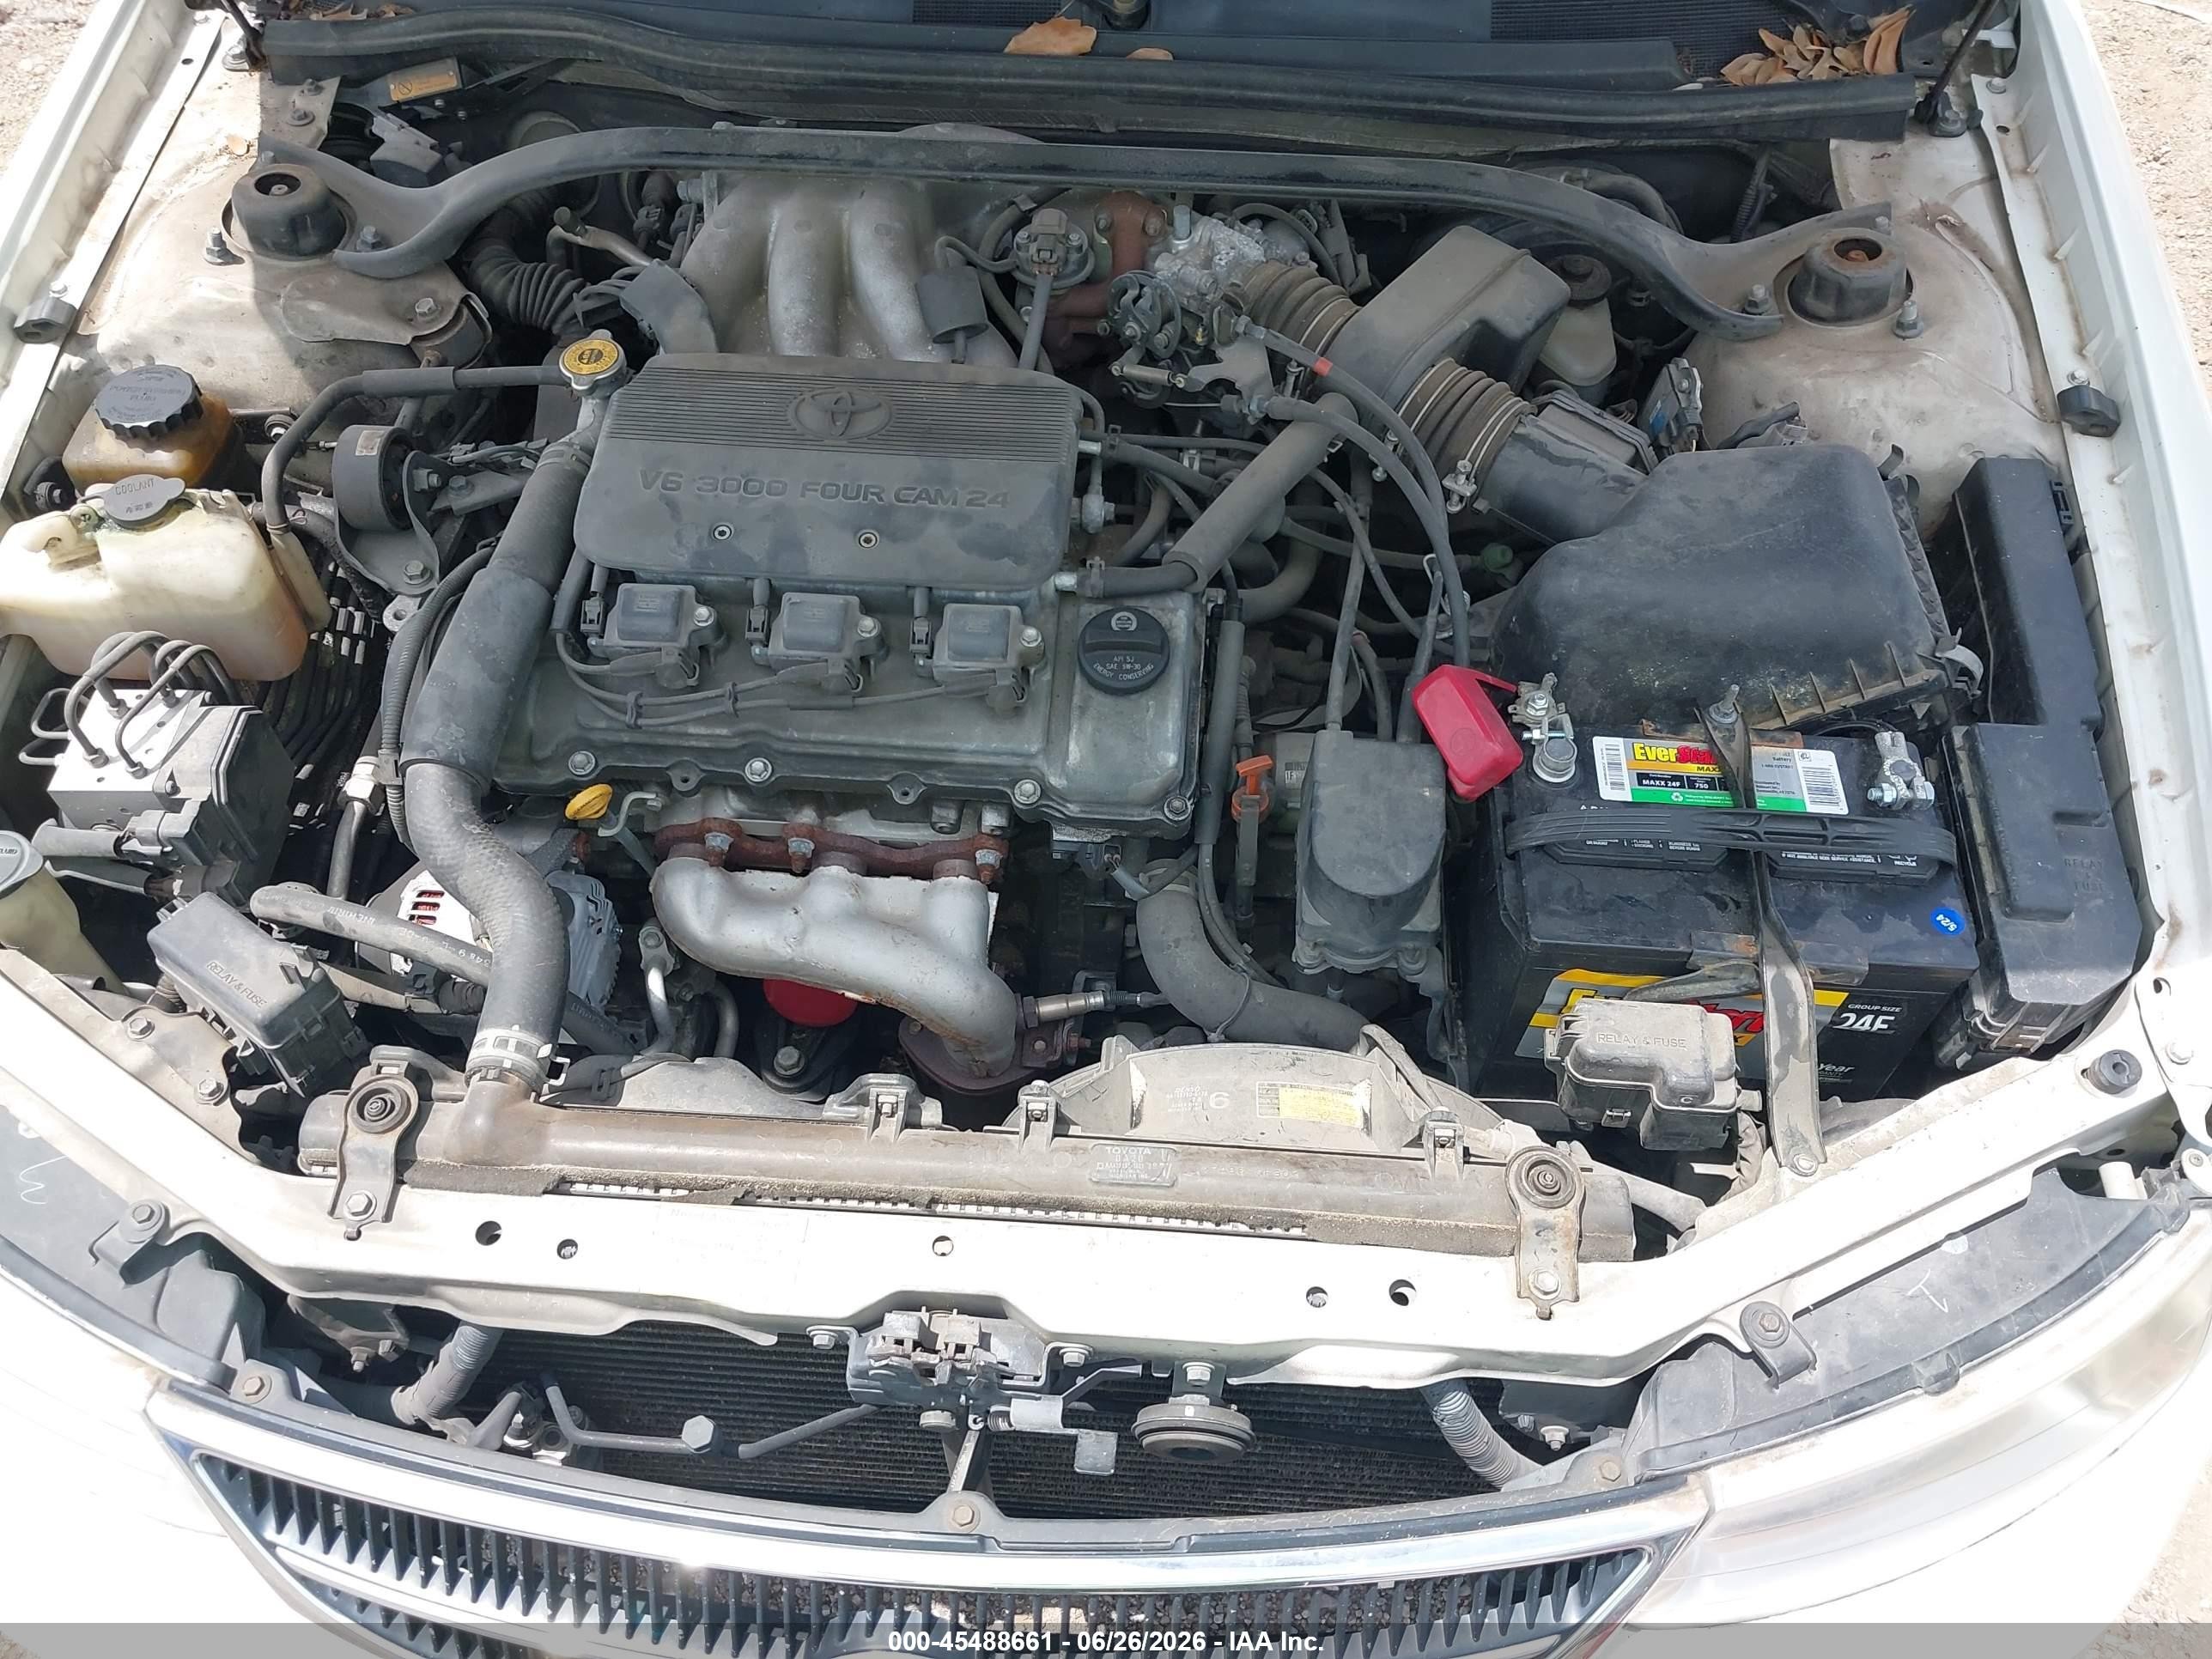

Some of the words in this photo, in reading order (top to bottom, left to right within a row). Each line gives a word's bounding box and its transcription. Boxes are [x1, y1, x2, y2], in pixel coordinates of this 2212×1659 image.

[115, 478, 155, 495] COOLANT
[639, 469, 684, 492] V6
[696, 475, 788, 498] 3000
[799, 481, 885, 503] FOUR
[893, 485, 957, 507] CAM
[965, 489, 1010, 509] 24
[1093, 662, 1114, 678] ENERGY
[1118, 663, 1154, 681] CONSERVING
[1936, 914, 1958, 932] 5/24
[206, 961, 238, 984] RELAY
[240, 988, 268, 1008] FUSE
[1836, 1012, 1895, 1031] 24F
[1597, 1032, 1637, 1045] RELAY
[1642, 1036, 1650, 1045] &
[1653, 1036, 1687, 1048] FUSE
[1209, 1091, 1231, 1109] 6
[1105, 1146, 1152, 1155] TOYOTA
